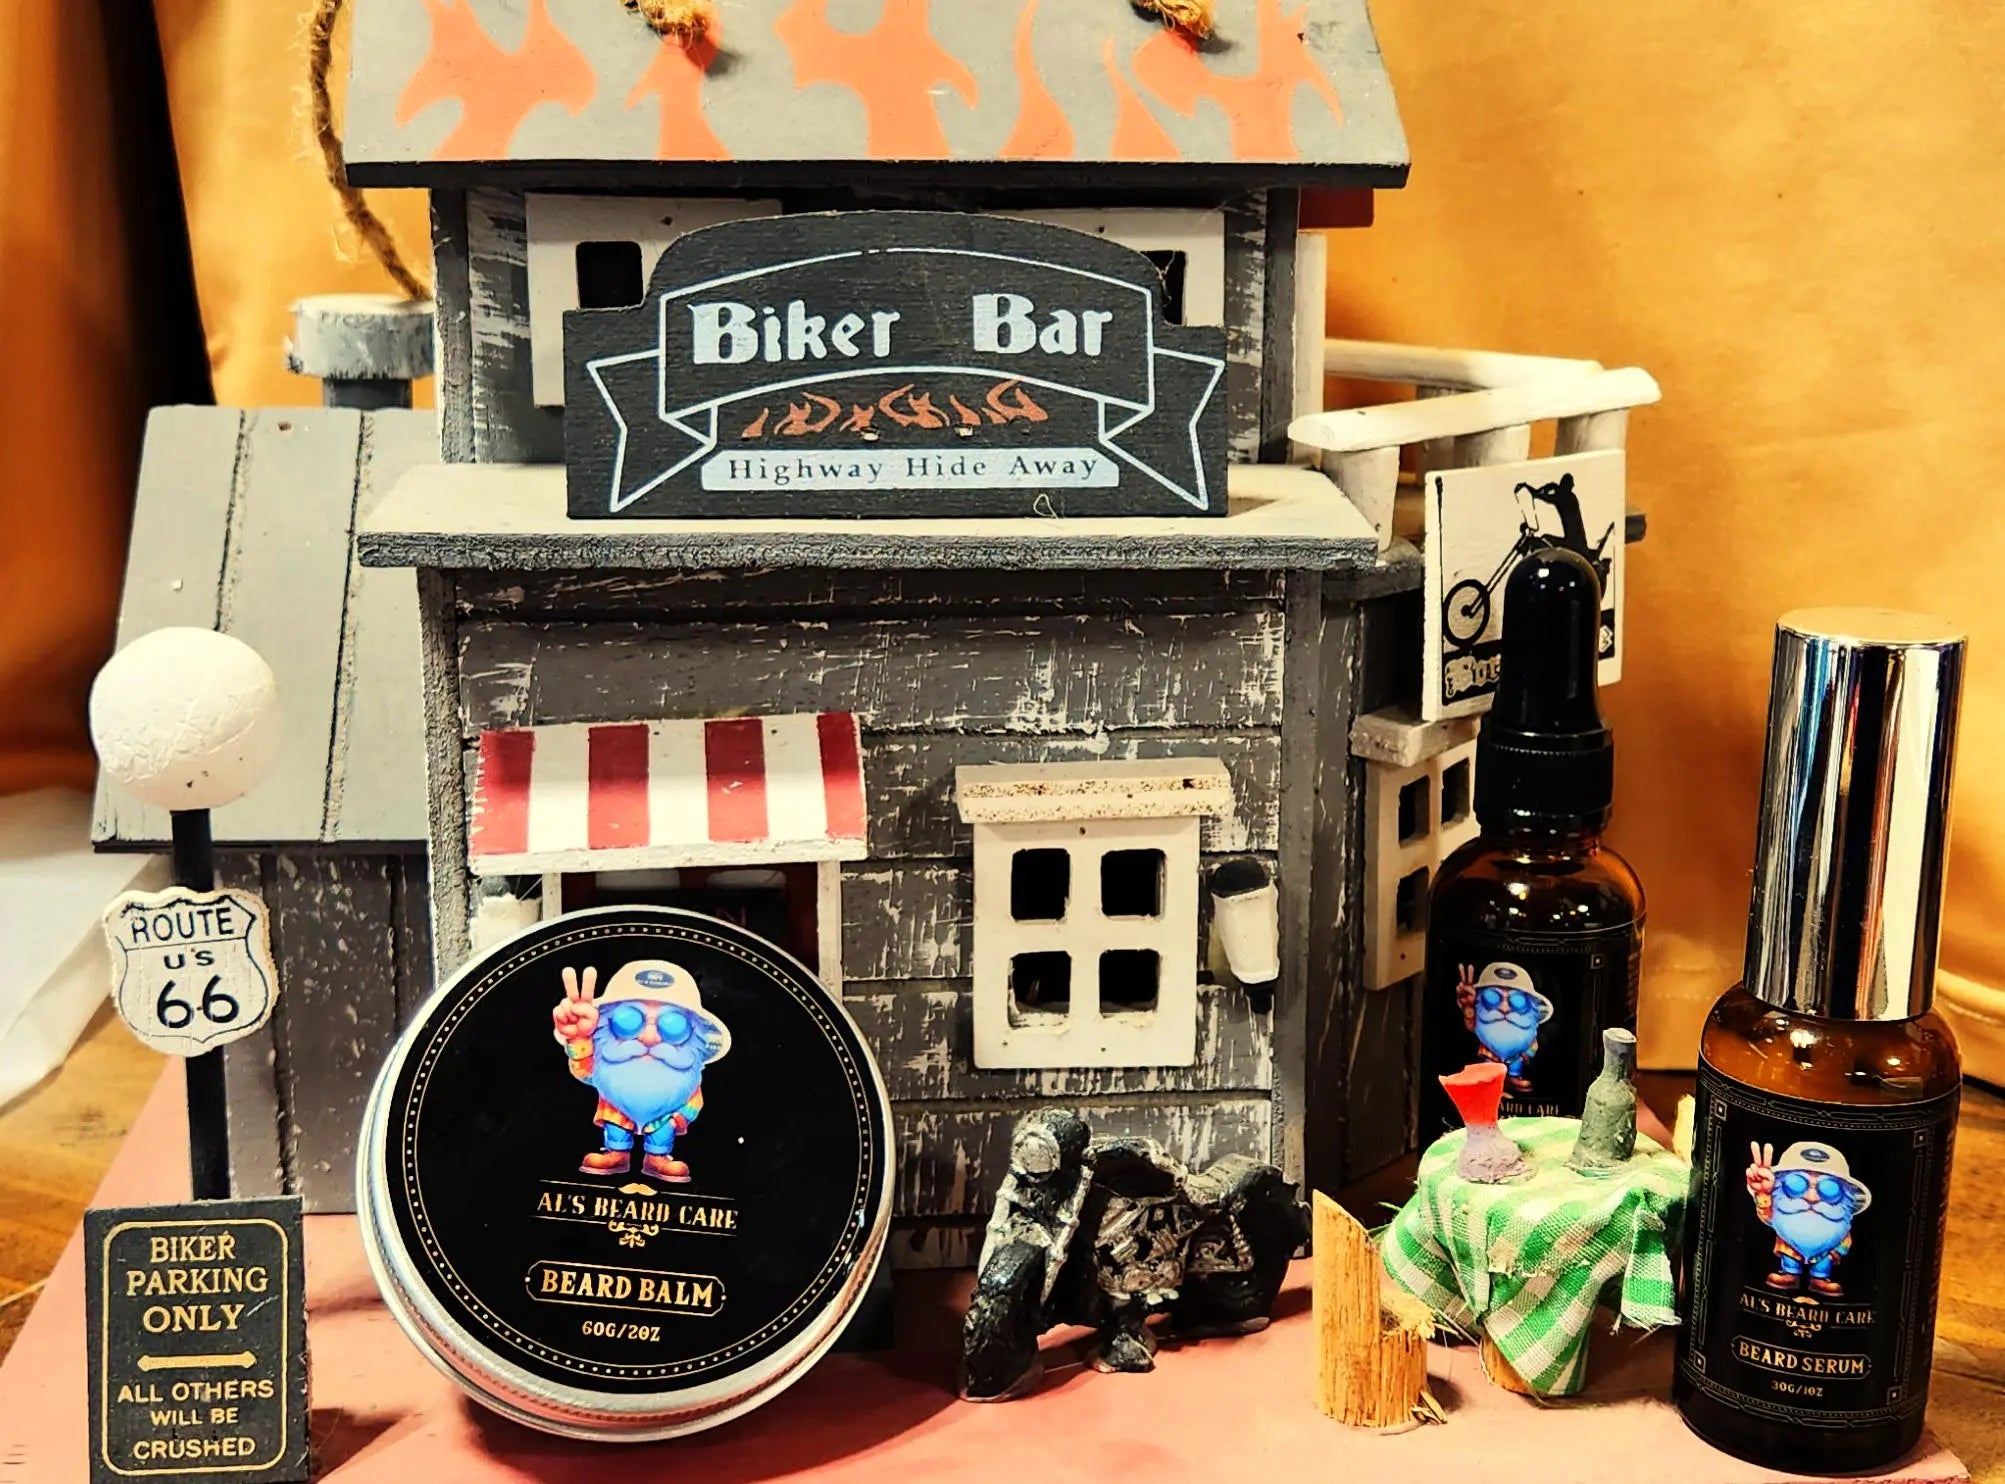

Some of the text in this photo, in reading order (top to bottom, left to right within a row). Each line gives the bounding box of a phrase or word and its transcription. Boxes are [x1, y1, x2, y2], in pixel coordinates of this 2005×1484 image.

[687, 293, 1114, 365] Biker Bar
[728, 455, 1098, 484] Highway Hide Away
[131, 908, 234, 943] ROUTE
[156, 974, 240, 1029] 66
[536, 1192, 739, 1230] AL'S BEARD CARE
[150, 1234, 236, 1262] BIKER
[126, 1266, 269, 1297] PARKING
[540, 1268, 714, 1308] BEARD BALM
[142, 1304, 245, 1333] ONLY
[1776, 1303, 1829, 1323] BEARD
[1835, 1310, 1876, 1324] CARE
[1739, 1341, 1865, 1374] BEARD SERUM
[117, 1379, 275, 1403] ALL OTHERS
[151, 1407, 239, 1426] WILL BE
[132, 1436, 257, 1460] CRUSHED
